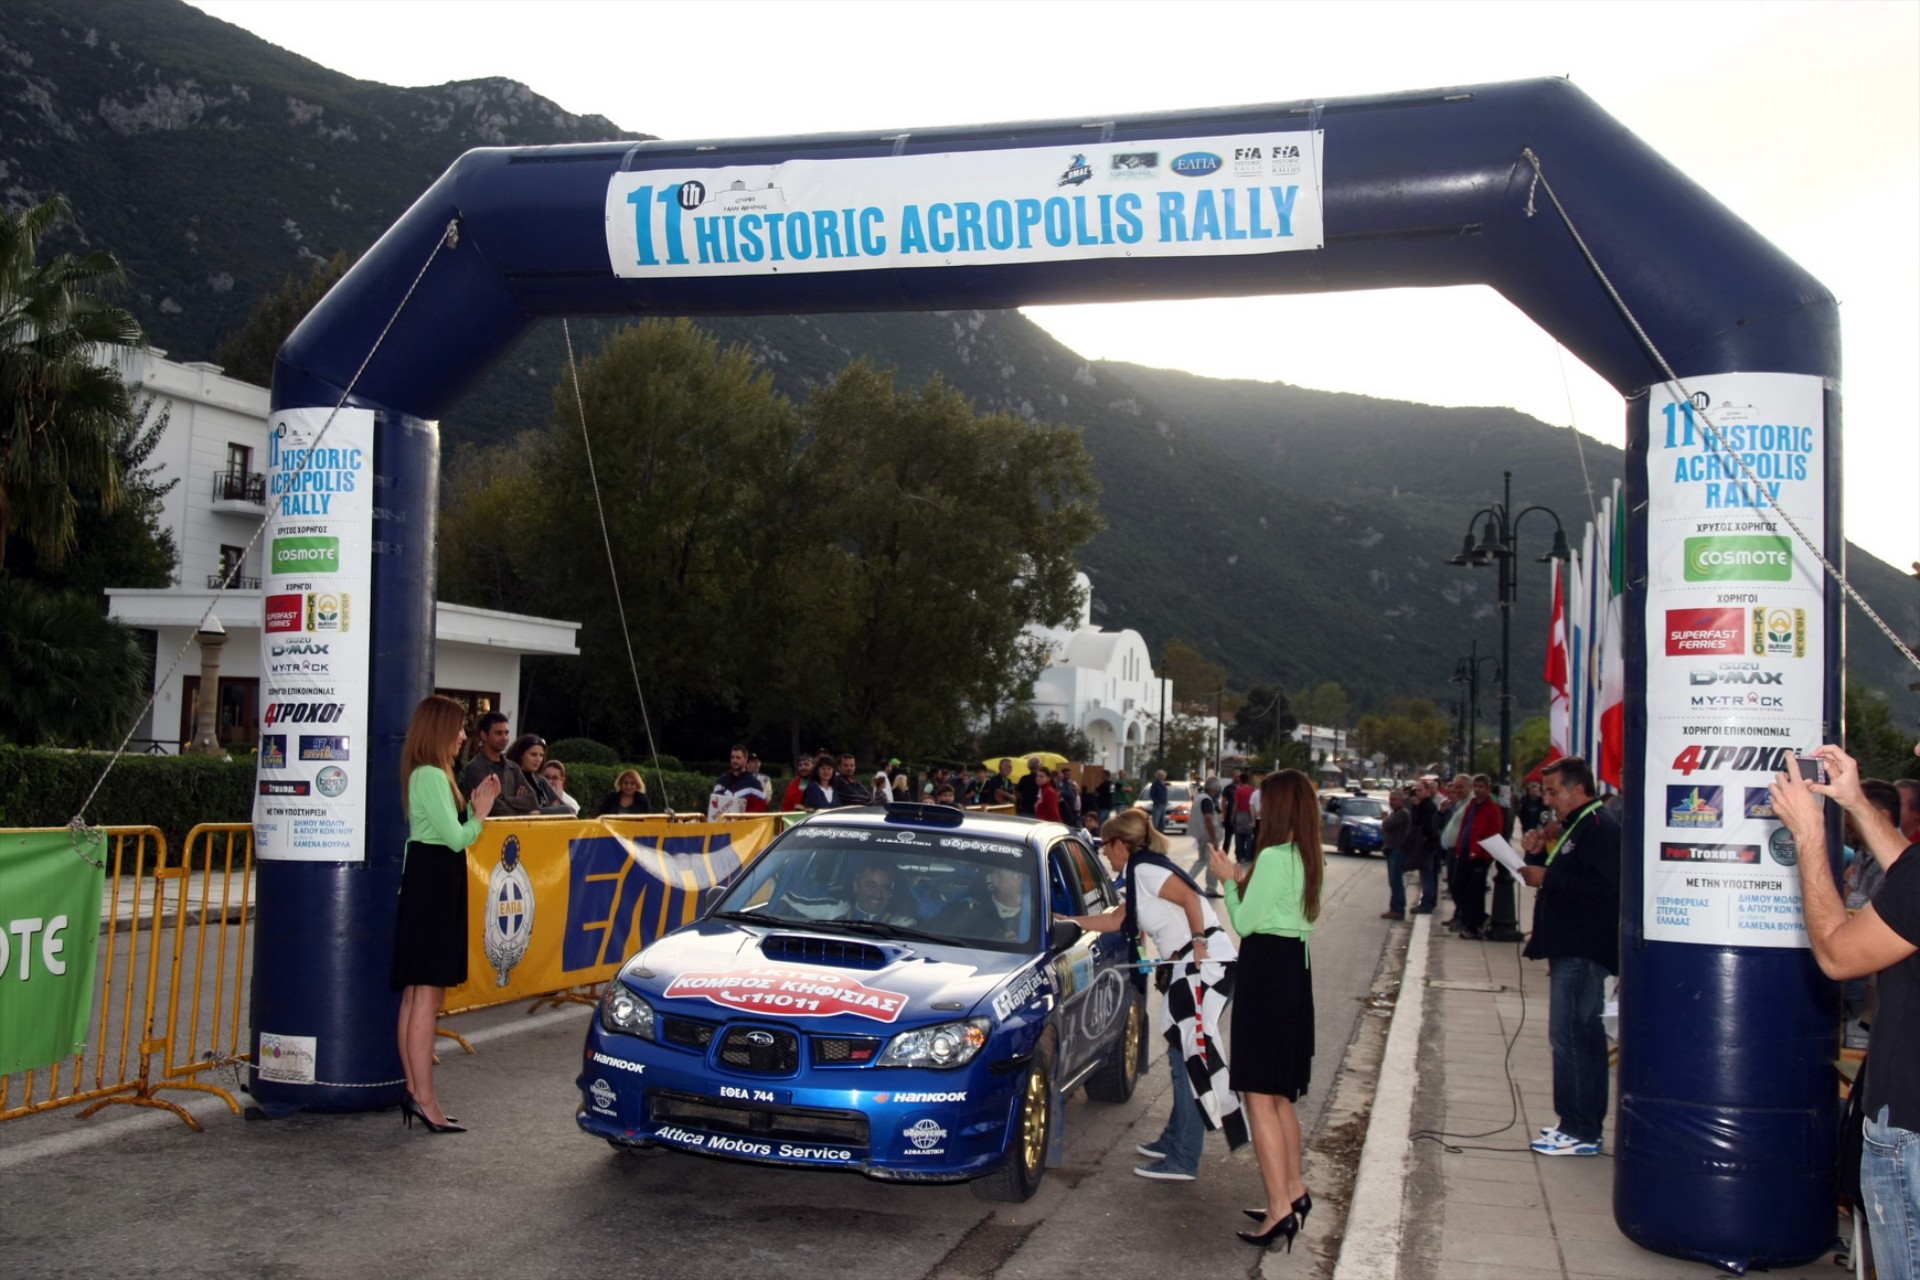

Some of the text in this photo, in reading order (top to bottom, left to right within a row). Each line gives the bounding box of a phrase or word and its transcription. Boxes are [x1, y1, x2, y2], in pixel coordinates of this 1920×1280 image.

[1177, 158, 1217, 171] ΕΛΠΑ
[694, 206, 887, 264] HISTORIC
[900, 192, 1144, 255] ACROPOLIS
[1157, 185, 1300, 243] RALLY
[1703, 424, 1813, 453] HISTORIC
[282, 448, 362, 471] HISTORIC
[1674, 452, 1808, 483] ACROPOLIS
[270, 471, 355, 495] ACROPOLIS
[1705, 482, 1782, 509] RALLY
[281, 493, 331, 516] RALLY
[1696, 522, 1778, 533] ΧΡΥΣΟΣ ΧΟΡΗΓΟΣ
[277, 548, 335, 562] COSMOTE
[1699, 550, 1788, 566] COSMOTE
[286, 583, 312, 591] ΧΟΡΗΓΟΙ
[1717, 594, 1758, 604] ΧΟΡΗΓΟΙ
[1671, 629, 1738, 641] SUPERFAST
[1678, 639, 1727, 650] FERRIES
[1719, 662, 1760, 671] ISUZU
[1683, 725, 1791, 737] ΧΟΡΗΓΟΙ ΕΠΙΚΟΙΝΩΝΙΑΣ
[940, 837, 1024, 857] υδρόγειος
[1773, 840, 1797, 851] bes
[1686, 878, 1782, 890] ΜΕ ΤΗΝ ΥΠΟΣΤΗΡΙΞΗ
[1656, 896, 1709, 907] ΠΕΡΙΦΕΡΕΙΑΣ
[1738, 894, 1771, 904] ΔΗΜΟΥ
[500, 900, 523, 915] ΕΛΠΑ
[1656, 907, 1689, 916] ΣΤΕΡΕΑΣ
[1656, 916, 1691, 926] ΕΛΛΑΔΑΣ
[1738, 921, 1776, 931] ΚΑΜΕΝΑ
[673, 977, 900, 1012] ΚΟΜΒΟΣ ΚΗΦΙΣΙΑΣ
[750, 992, 821, 1011] 11011
[753, 1090, 775, 1102] 744
[655, 1125, 852, 1161] Attica Motors Service
